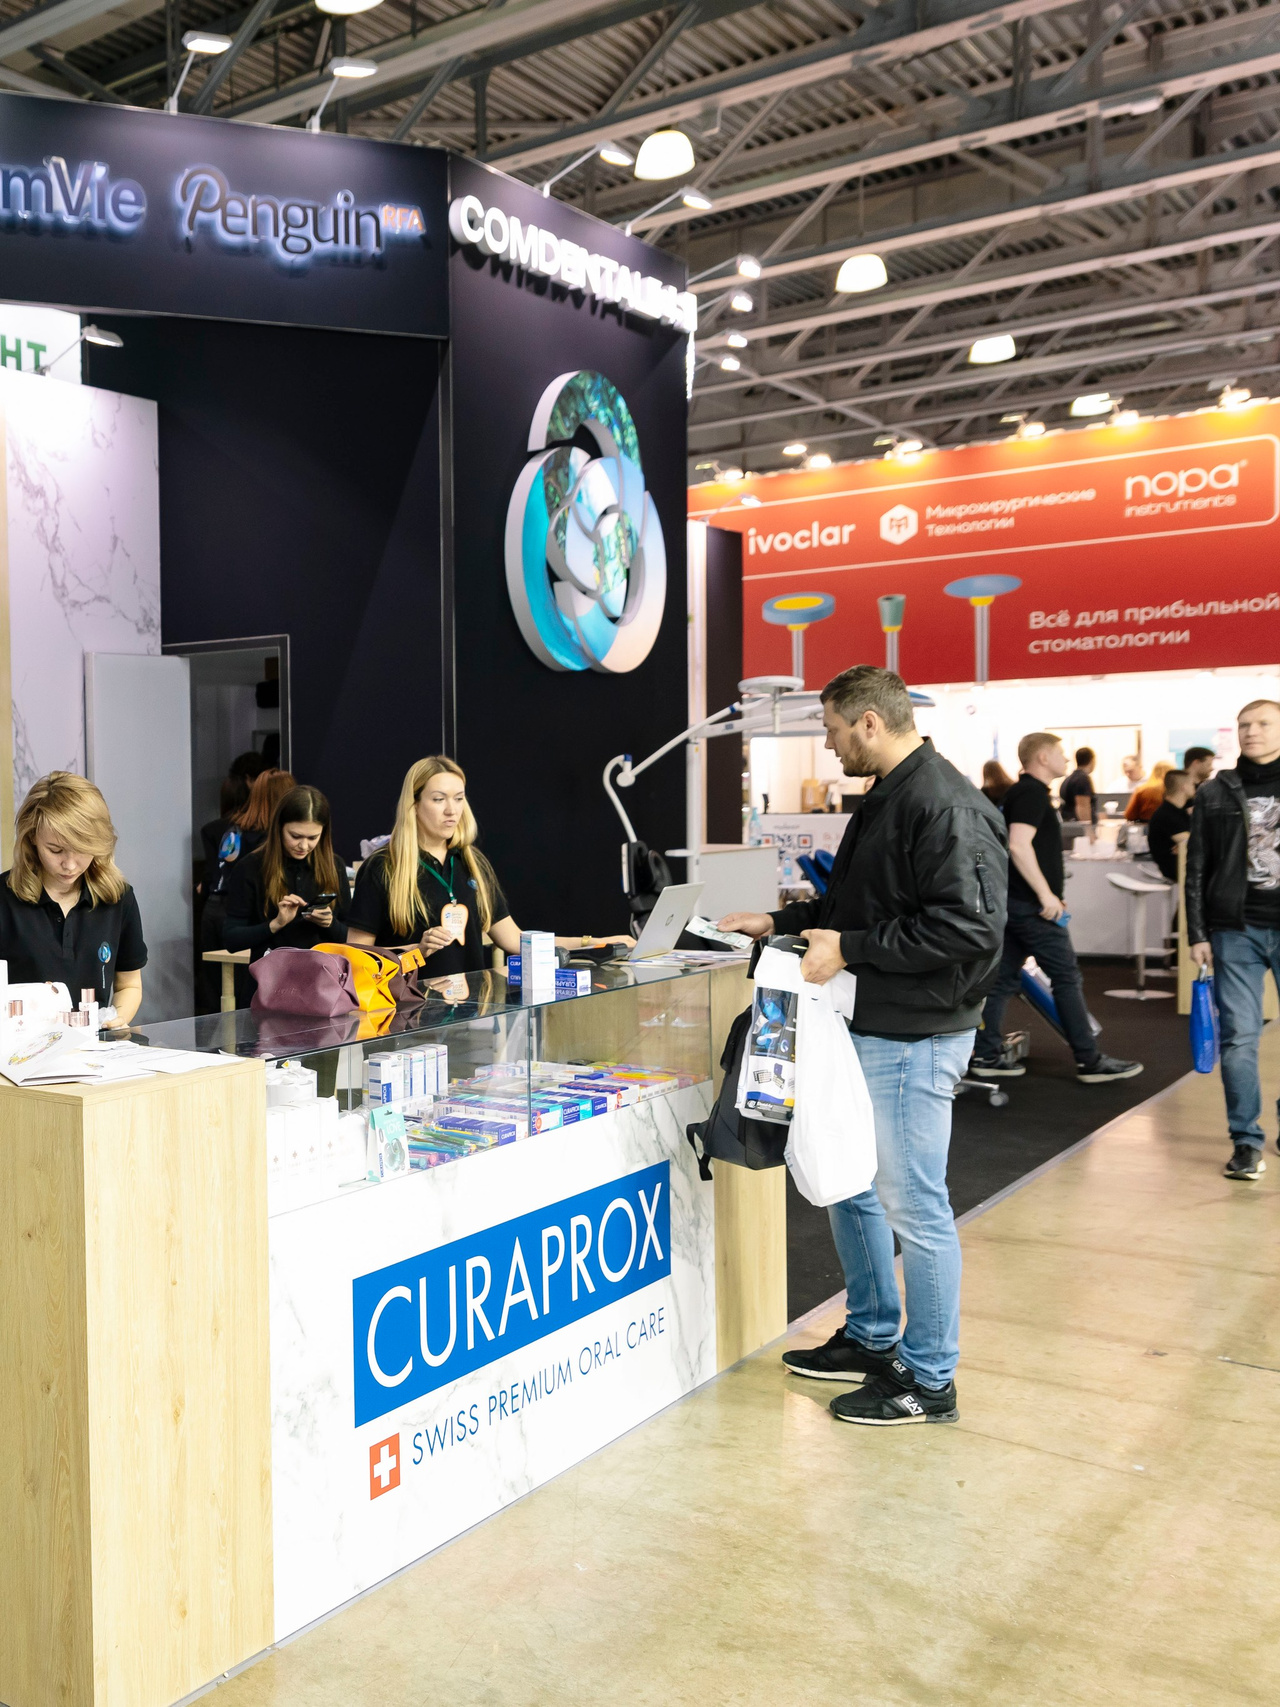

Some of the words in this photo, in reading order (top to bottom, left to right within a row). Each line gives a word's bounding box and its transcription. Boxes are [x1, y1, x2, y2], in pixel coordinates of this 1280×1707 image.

[178, 167, 382, 255] Penguin
[1125, 462, 1241, 500] nopa
[926, 488, 1097, 519] Микрохирургические
[748, 520, 856, 556] ivoclar
[926, 516, 1015, 538] Технологии
[1029, 610, 1070, 629] Всё
[1074, 608, 1119, 628] для
[1124, 592, 1280, 625] прибыльной
[1028, 629, 1190, 654] стоматологии
[367, 1182, 664, 1388] CURAPROX
[412, 1404, 479, 1465] SWISS
[488, 1356, 573, 1426] PREMIUM
[578, 1331, 621, 1376] ORAL
[626, 1306, 665, 1349] CARE
